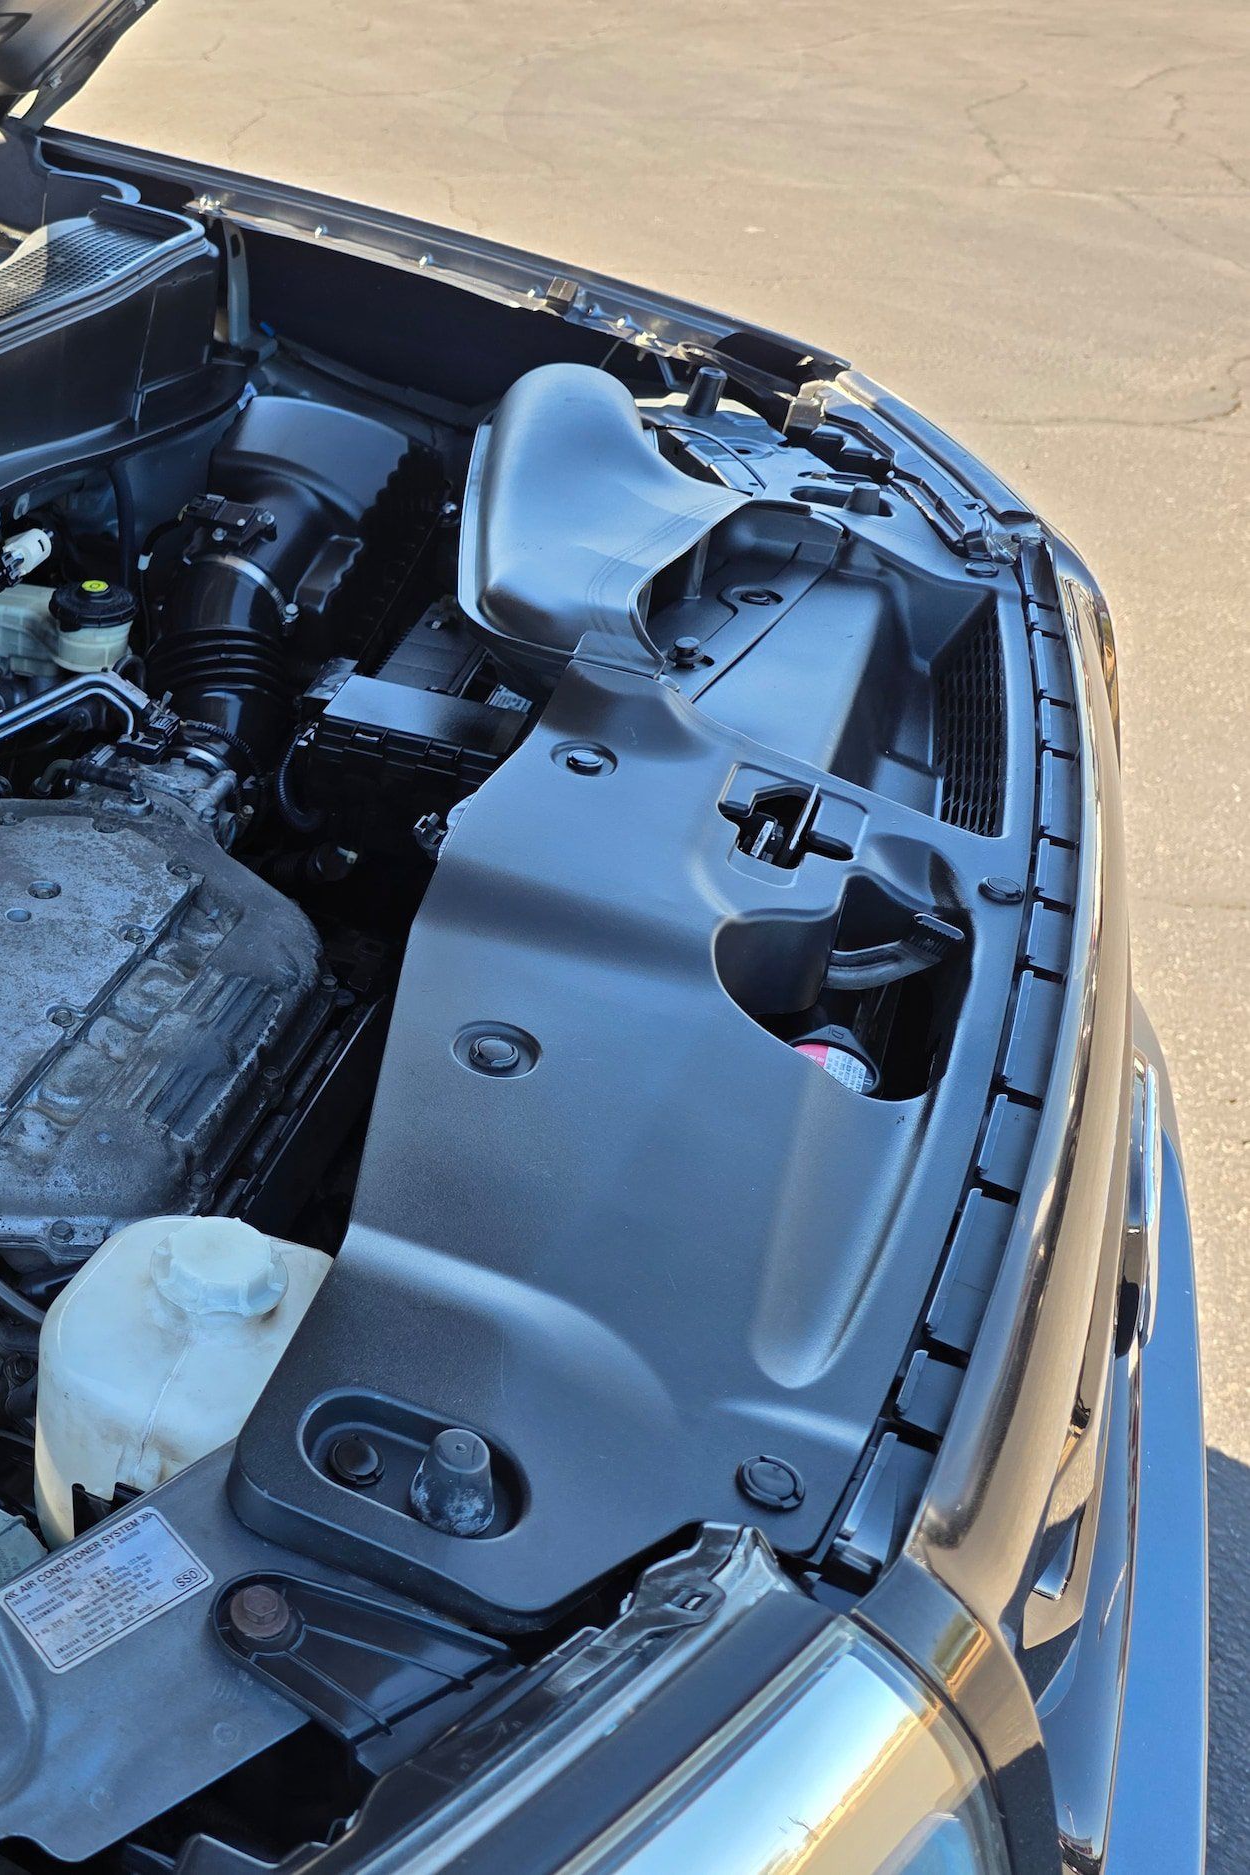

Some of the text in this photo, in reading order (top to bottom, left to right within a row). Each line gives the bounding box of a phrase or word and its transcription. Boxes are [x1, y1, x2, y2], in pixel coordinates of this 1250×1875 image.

[17, 1578, 37, 1593] AIR
[34, 1540, 101, 1583] CONDITIONER
[100, 1517, 140, 1544] SYSTEM
